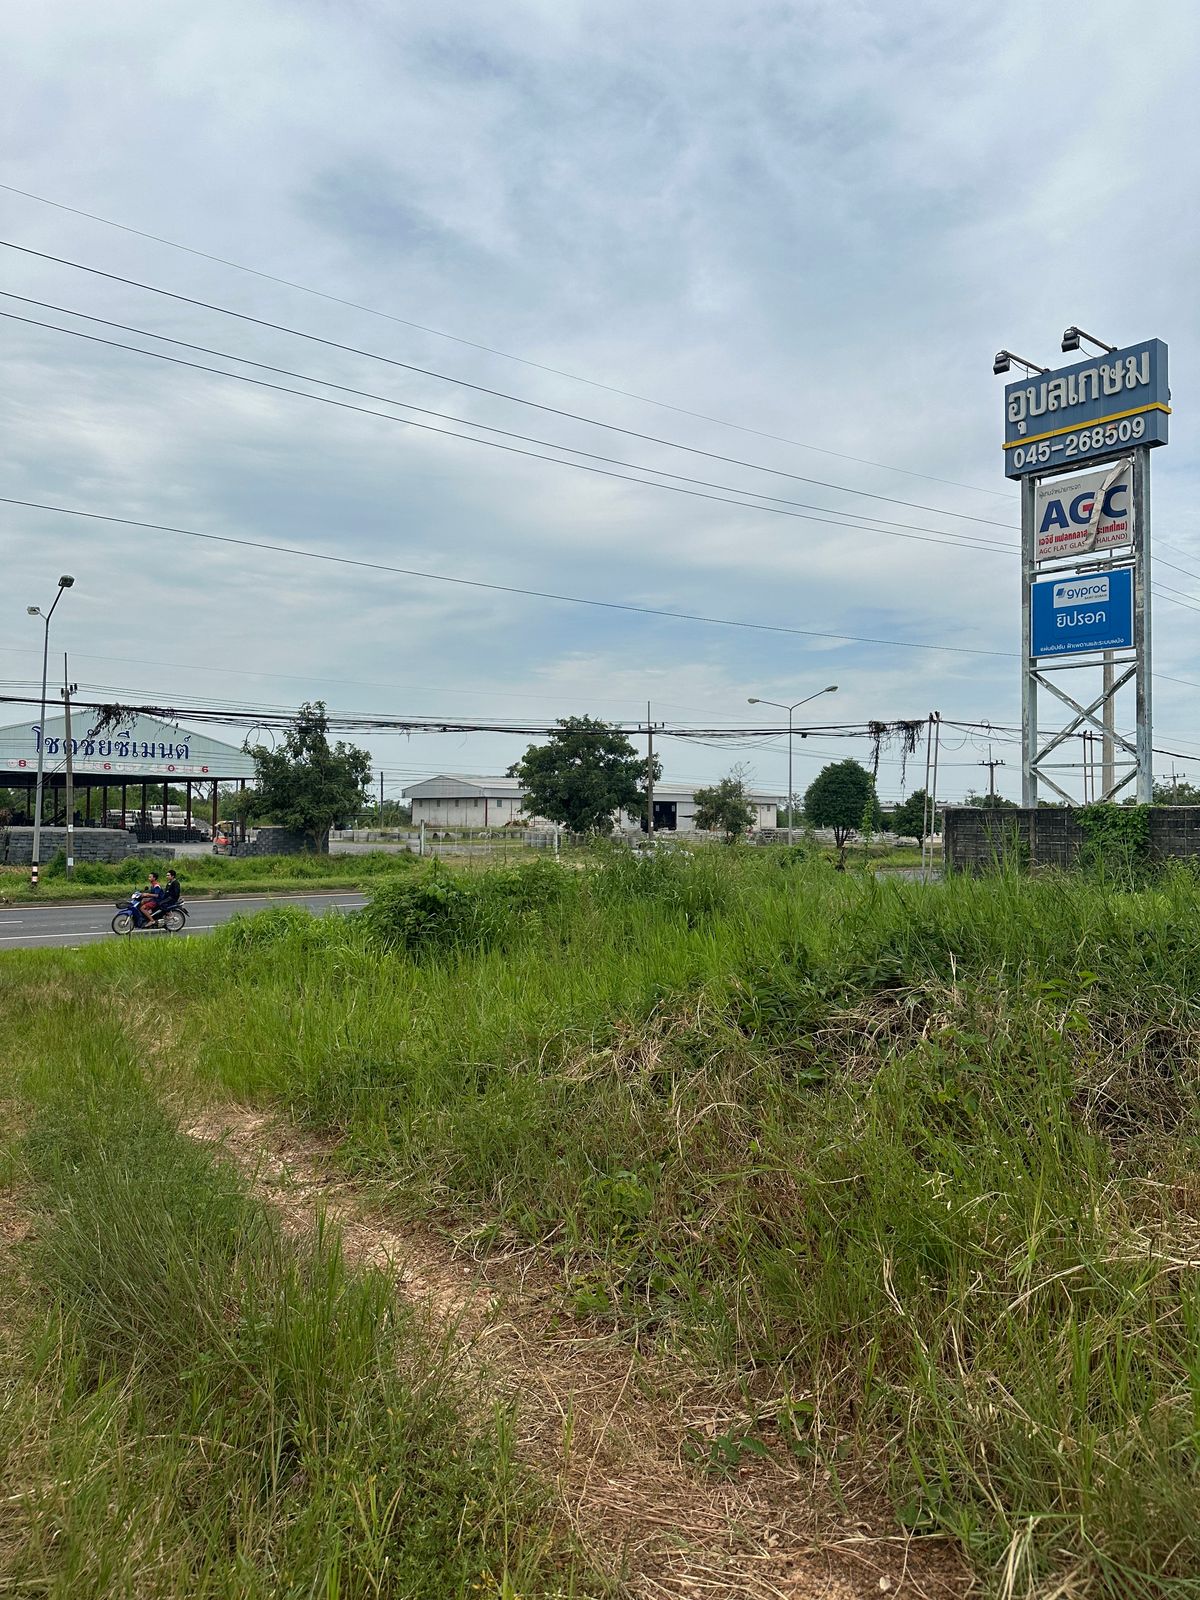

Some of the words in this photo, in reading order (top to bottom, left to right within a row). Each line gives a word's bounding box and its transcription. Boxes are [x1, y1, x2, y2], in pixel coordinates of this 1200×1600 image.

[1008, 351, 1150, 435] อุบลเกษม
[1013, 416, 1146, 468] 045-268509
[1039, 484, 1128, 533] AGC
[1038, 546, 1052, 555] AGC
[1053, 543, 1068, 552] FLAT
[1069, 540, 1086, 549] GLAS
[1066, 584, 1107, 600] gyproc
